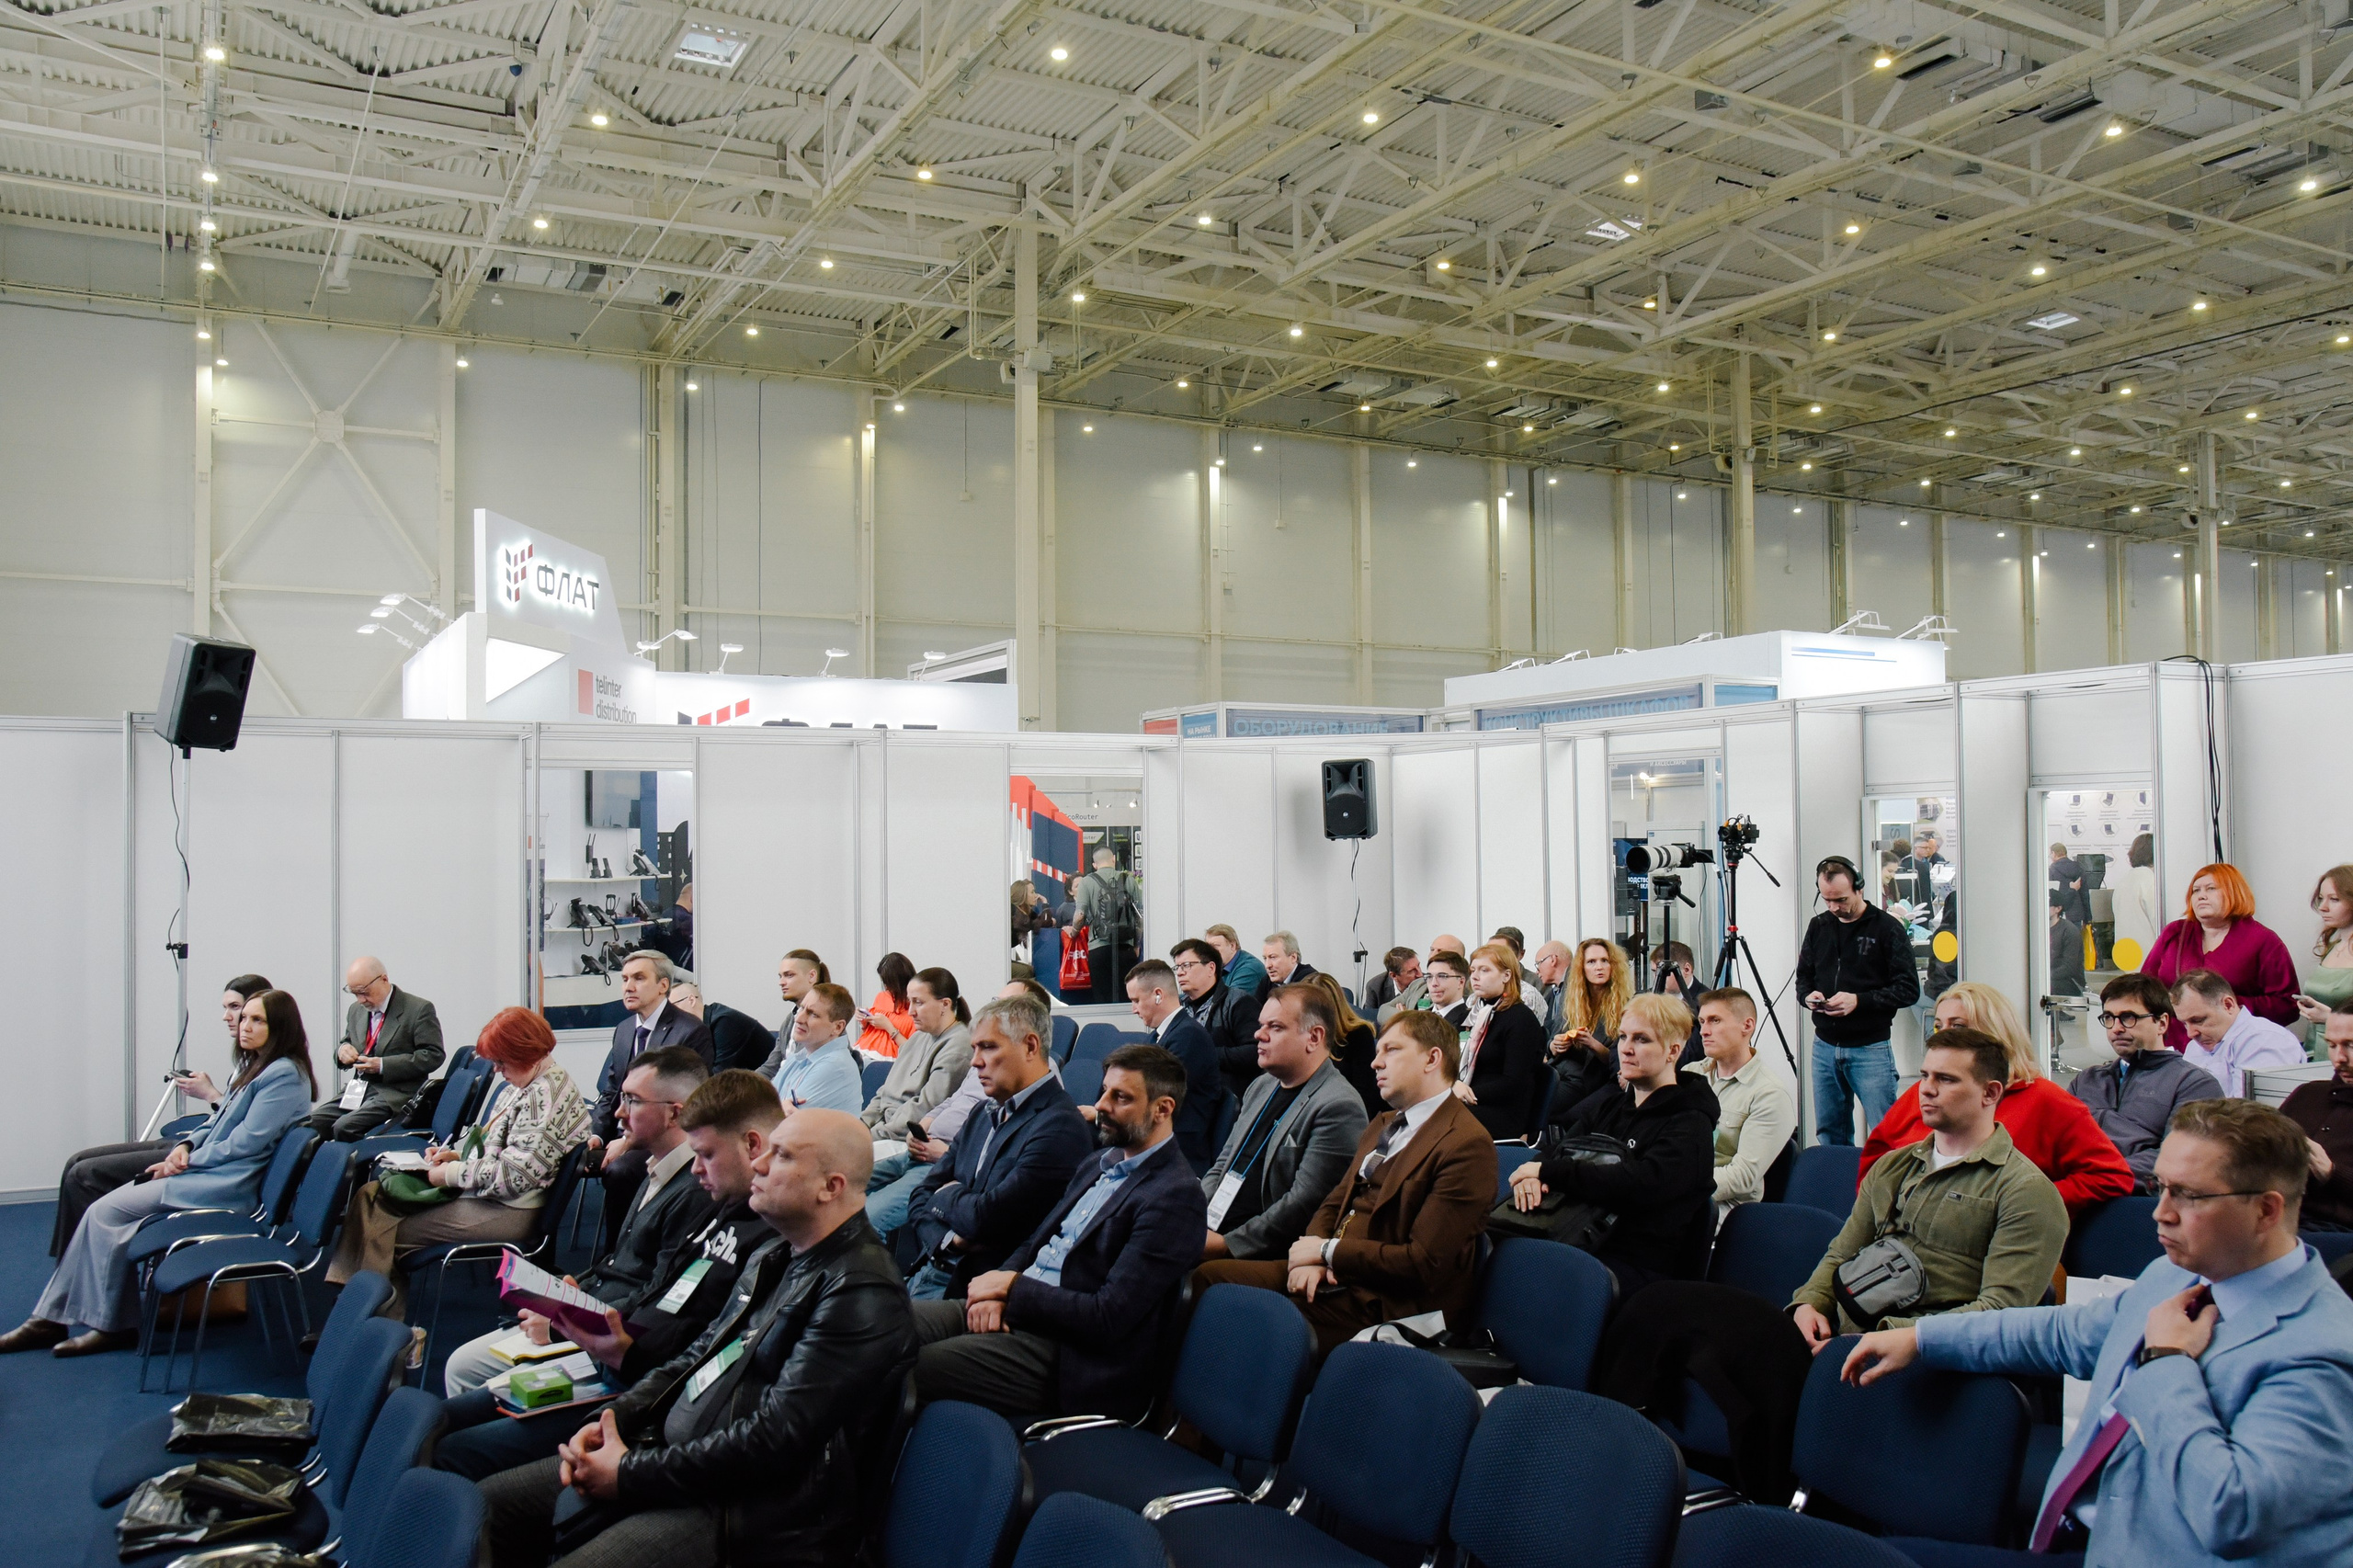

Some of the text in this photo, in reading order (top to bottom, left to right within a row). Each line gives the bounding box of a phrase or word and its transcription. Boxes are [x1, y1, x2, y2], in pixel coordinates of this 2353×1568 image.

[537, 563, 599, 610] ФЛАТ
[596, 675, 621, 699] telinter
[596, 699, 637, 724] distribution
[1233, 718, 1390, 736] ОБОРУДОВАНИЕ
